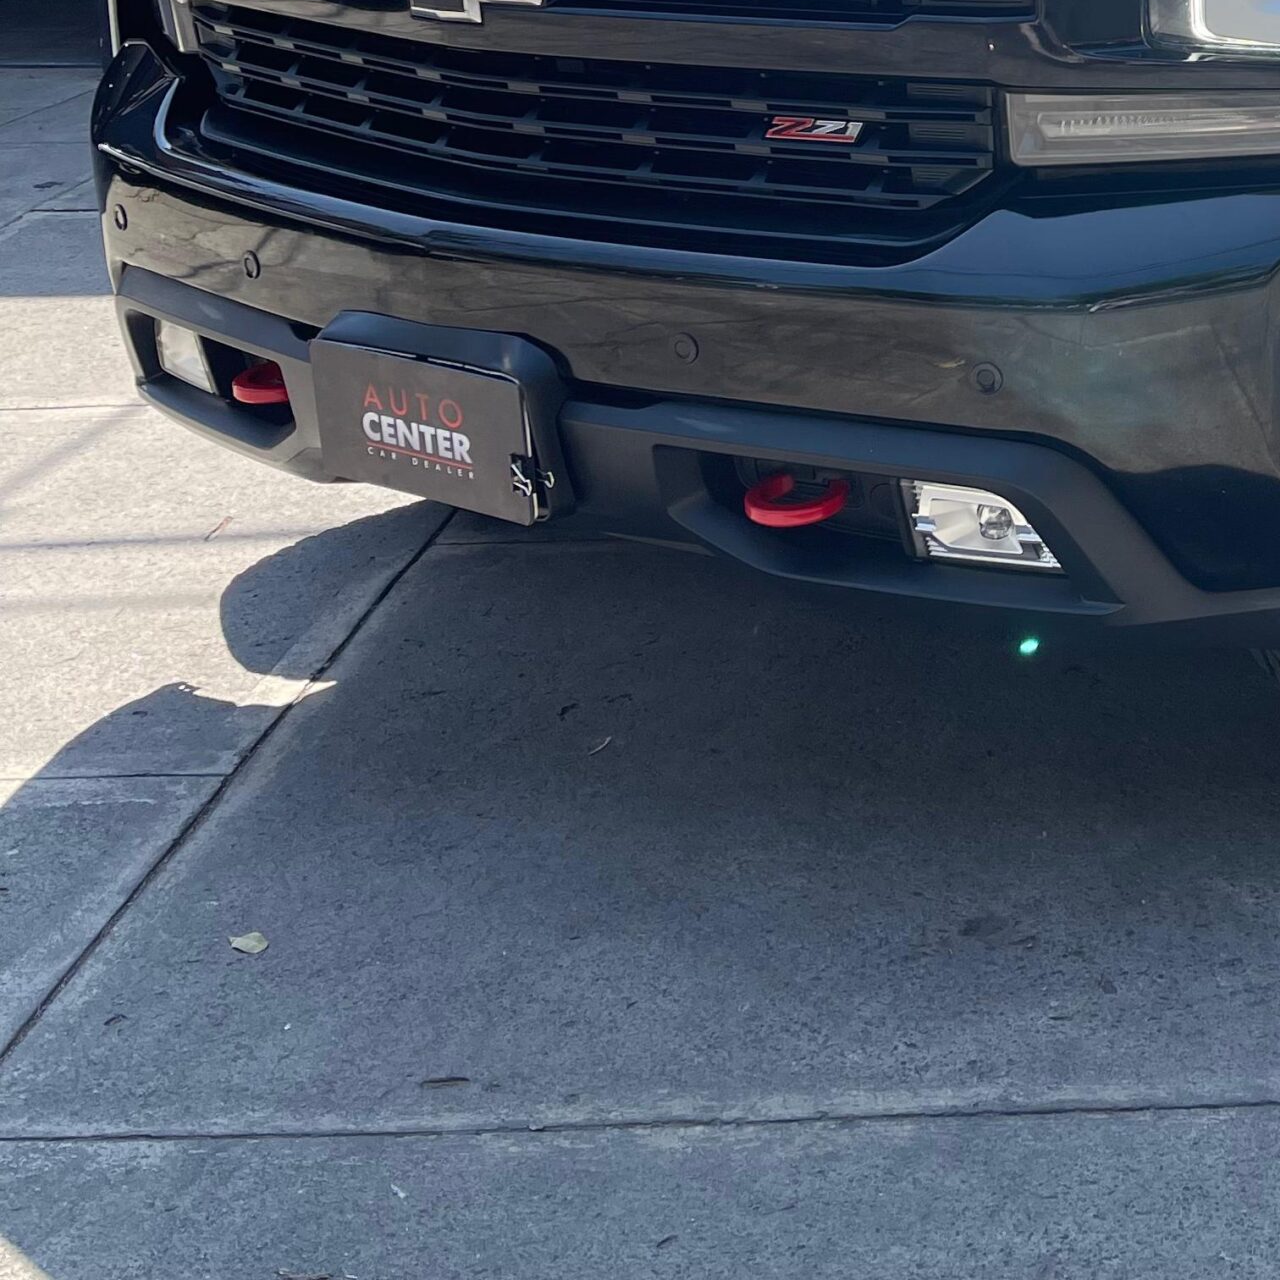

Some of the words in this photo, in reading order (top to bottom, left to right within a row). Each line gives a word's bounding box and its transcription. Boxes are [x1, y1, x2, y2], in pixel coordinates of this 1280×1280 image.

[765, 116, 864, 143] Z71
[363, 382, 464, 428] AUTO
[362, 411, 473, 464] CENTER
[367, 446, 397, 460] CAR
[411, 457, 475, 479] DEALER
